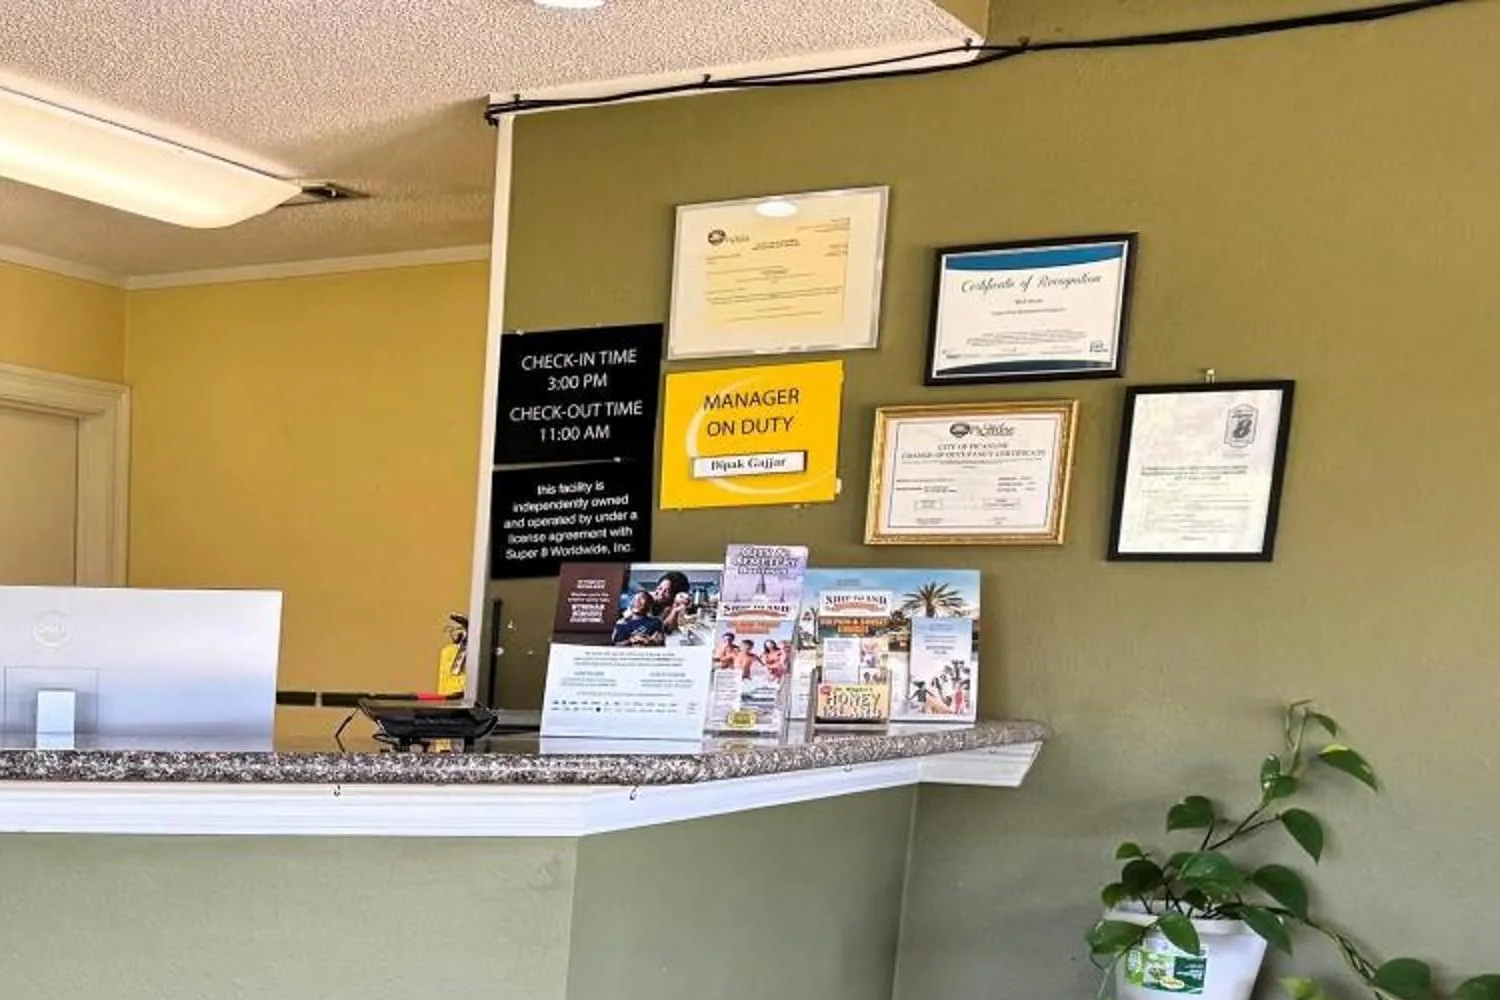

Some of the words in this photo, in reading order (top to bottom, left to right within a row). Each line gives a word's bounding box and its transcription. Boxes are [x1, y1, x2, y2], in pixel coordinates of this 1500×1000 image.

[521, 351, 596, 371] CHECK-IN
[598, 348, 638, 366] TIME
[547, 375, 580, 392] 3:00
[583, 372, 609, 389] PM
[703, 388, 800, 411] MANAGER
[508, 402, 603, 422] CHECK-OUT
[604, 400, 644, 417] TIME
[539, 425, 582, 442] 11:00
[583, 423, 612, 440] AM
[707, 420, 736, 437] ON
[740, 416, 795, 435] DUTY
[536, 484, 557, 496] this
[557, 481, 593, 495] facility
[595, 480, 605, 491] is
[512, 496, 589, 513] independently
[590, 493, 630, 506] owned
[503, 517, 525, 529] and
[527, 513, 577, 529] operated
[577, 512, 593, 525] by
[594, 510, 628, 522] under
[629, 511, 638, 521] a
[507, 532, 547, 544] license
[548, 528, 608, 545] agreement
[609, 526, 633, 538] with
[505, 547, 540, 560] Super
[550, 543, 612, 557] Worldwide,
